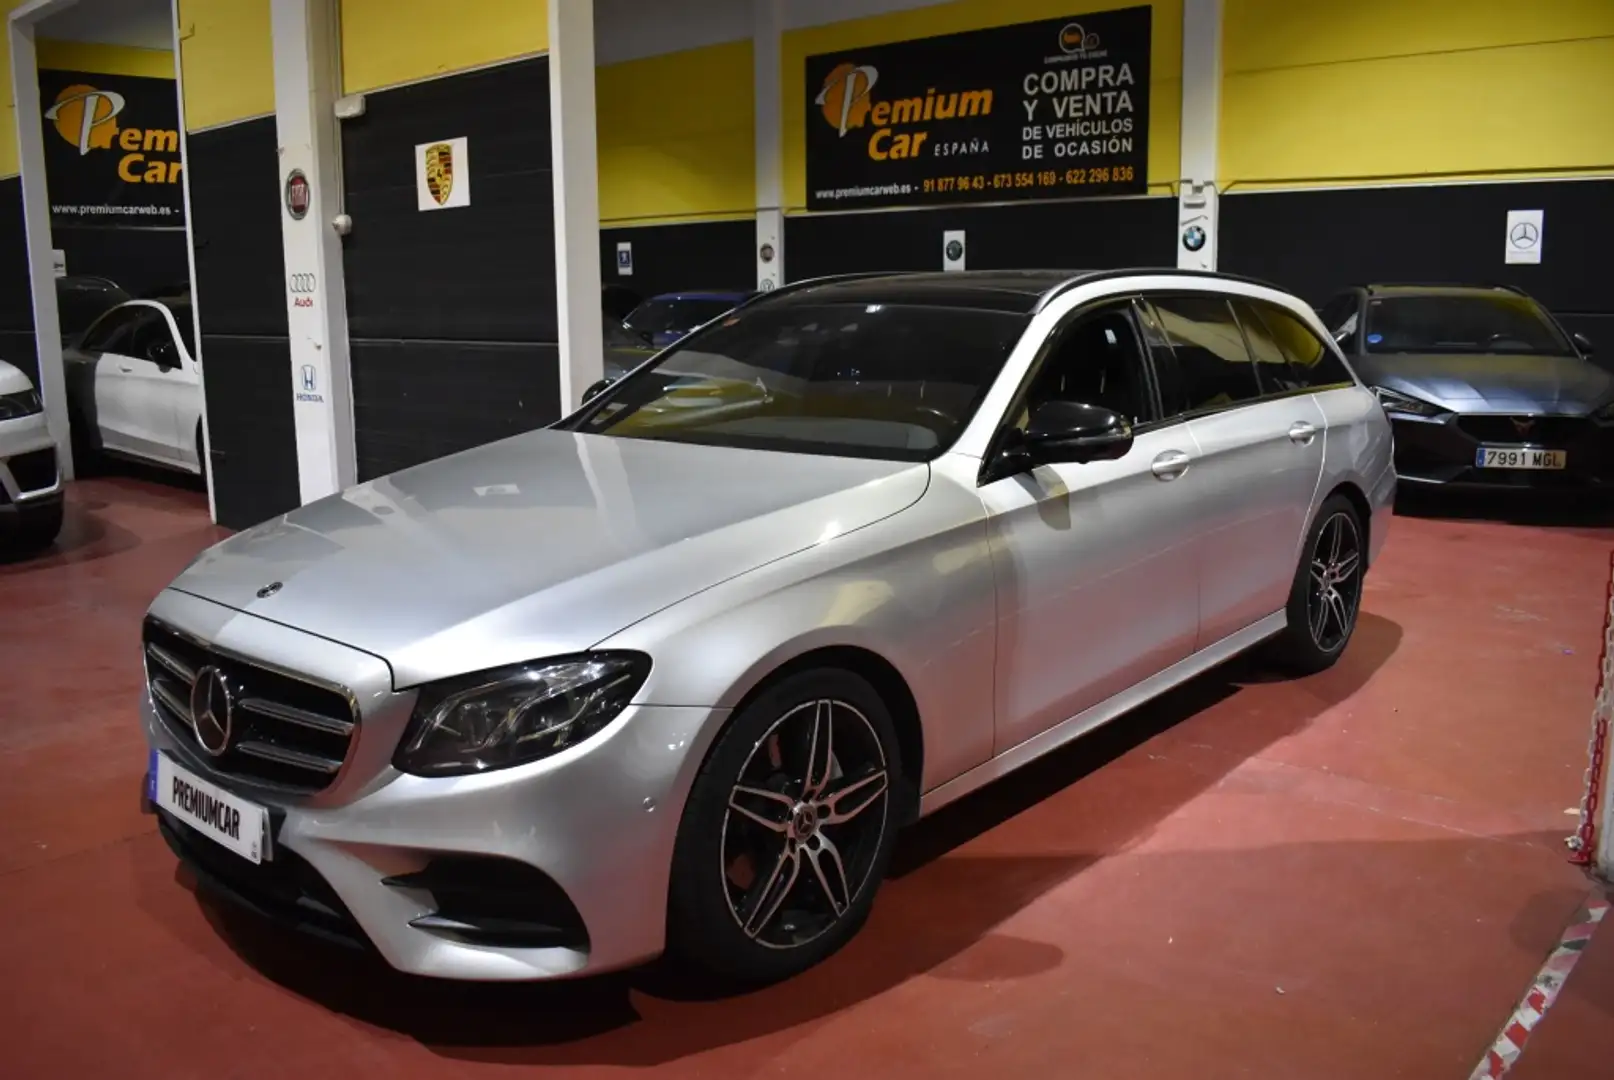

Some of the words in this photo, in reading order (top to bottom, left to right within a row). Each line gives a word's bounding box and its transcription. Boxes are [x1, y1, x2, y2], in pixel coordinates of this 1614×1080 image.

[1023, 62, 1135, 96] COMPRA
[815, 64, 993, 138] Premium
[1022, 99, 1038, 122] Y
[1052, 91, 1134, 119] VENTA
[868, 127, 928, 161] Car
[934, 138, 990, 157] ESPAÑA
[1022, 126, 1042, 141] DE
[1045, 118, 1133, 139] VEHÍCULOS
[1022, 144, 1043, 160] DE
[1054, 135, 1133, 158] OCASIÓN
[118, 153, 182, 184] Car
[815, 182, 912, 200] www.premiumcarweb.es
[923, 178, 935, 194] 91
[937, 176, 955, 192] 877
[972, 175, 984, 190] 43
[993, 174, 1012, 189] 673
[1014, 172, 1034, 188] 554
[1065, 169, 1086, 185] 622
[1088, 168, 1109, 184] 296
[1112, 166, 1133, 182] 836
[52, 203, 171, 217] www.premiumcarweb.es
[294, 296, 313, 308] Audi
[296, 393, 324, 403] HONDA
[1487, 451, 1526, 466] 7991
[1532, 452, 1562, 467] MGL
[172, 775, 241, 841] PREMIUMCAR
